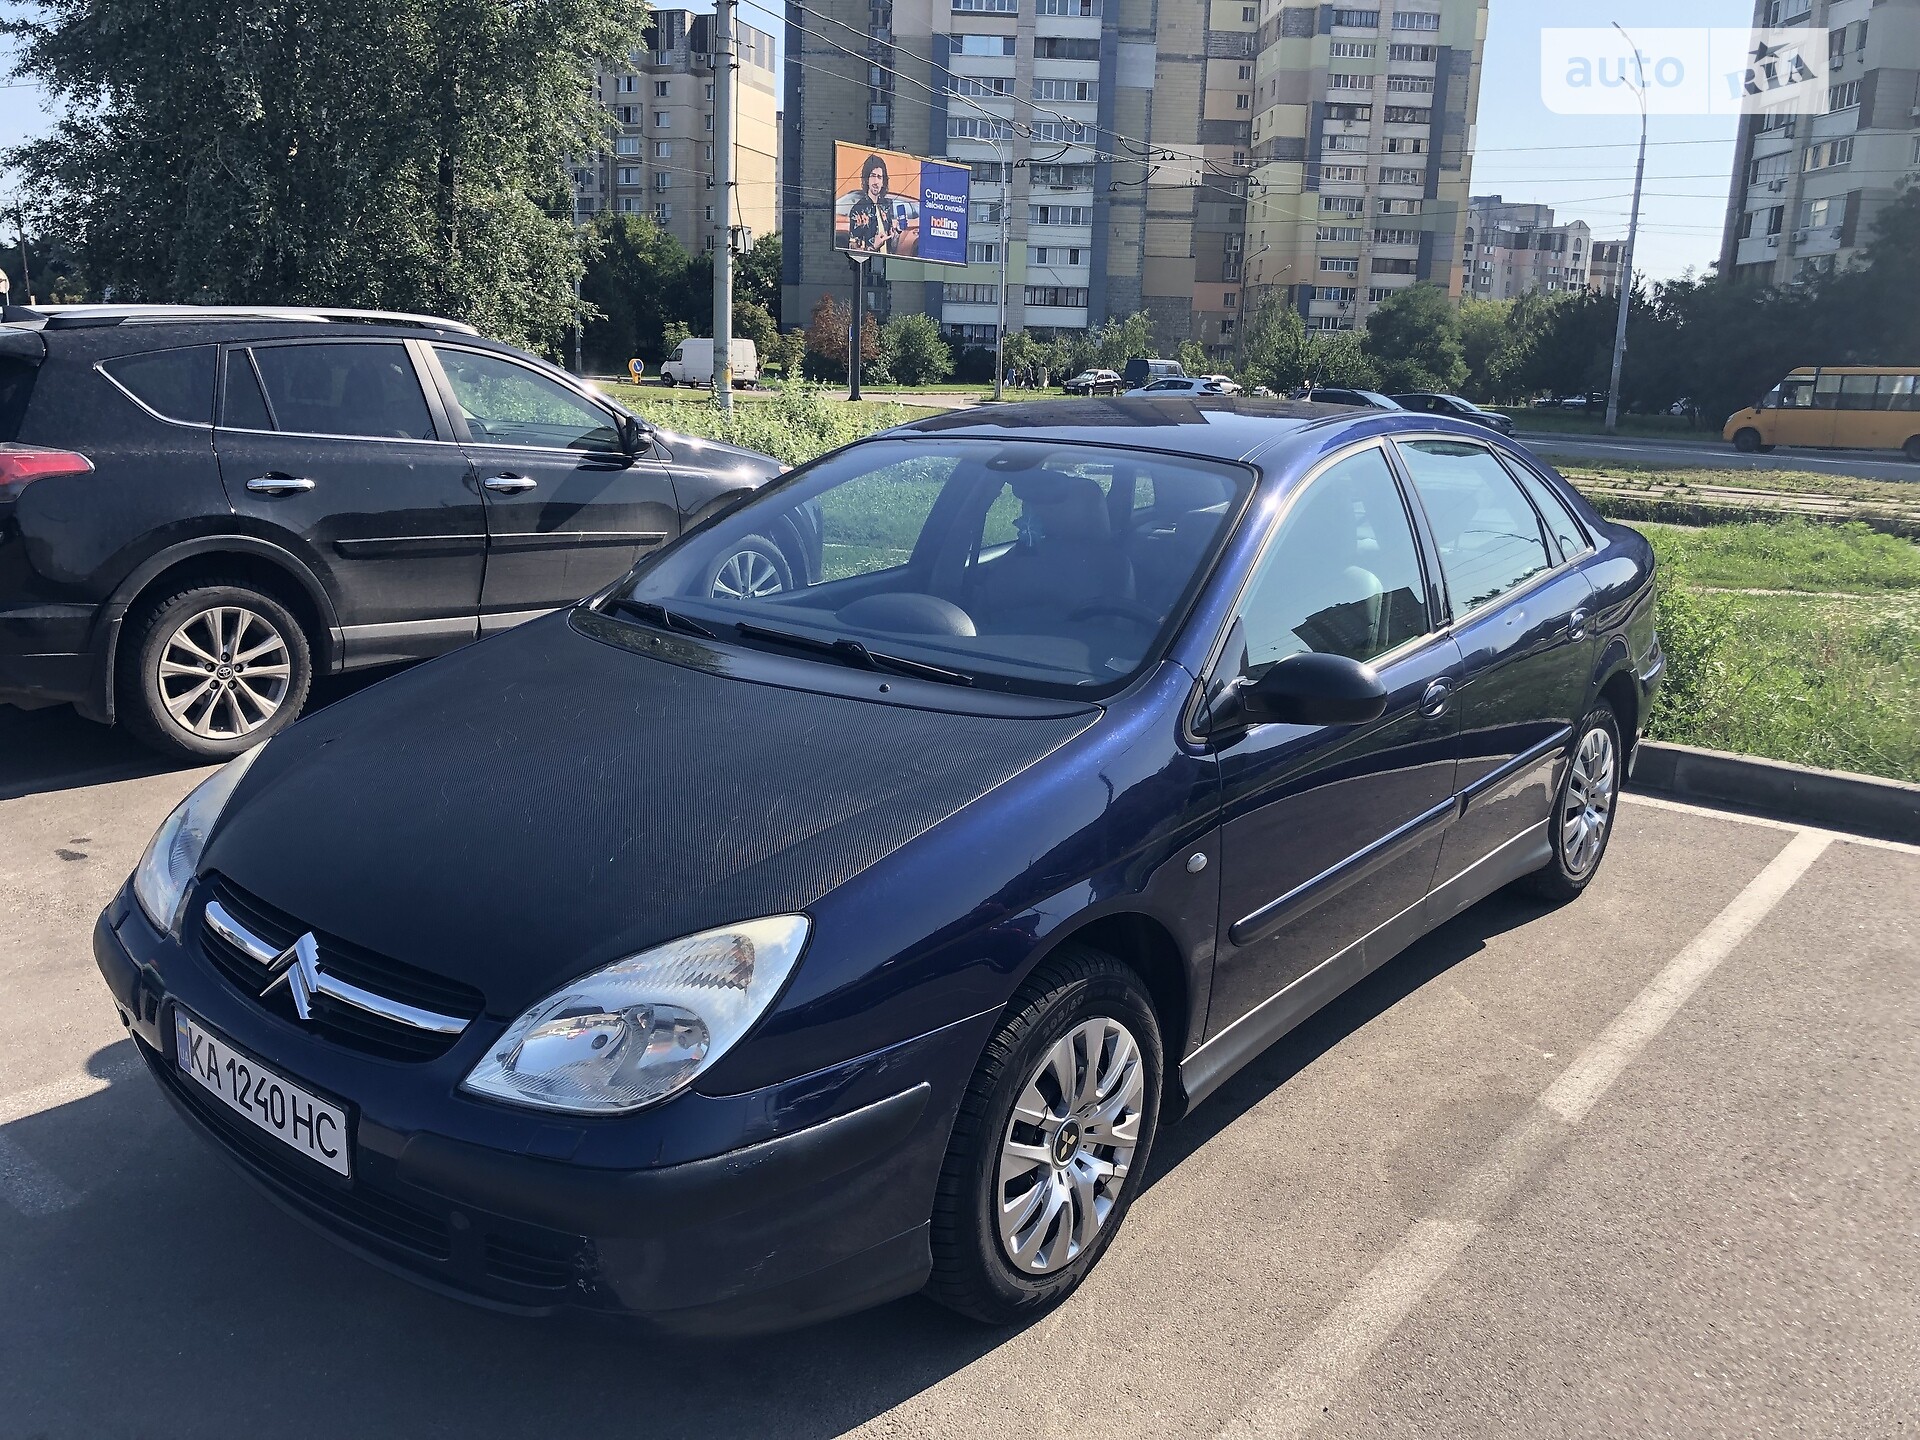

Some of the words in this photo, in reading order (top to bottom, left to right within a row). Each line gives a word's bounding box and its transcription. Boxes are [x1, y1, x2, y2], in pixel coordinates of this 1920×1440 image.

[925, 188, 967, 204] Страховка?
[924, 199, 944, 211] Звісно
[944, 203, 966, 214] онлайн
[930, 215, 958, 230] hotline
[932, 229, 957, 238] FINANCE
[179, 1045, 190, 1063] UA
[188, 1026, 222, 1091] KA
[225, 1057, 286, 1130] 1240
[291, 1093, 338, 1159] HC
